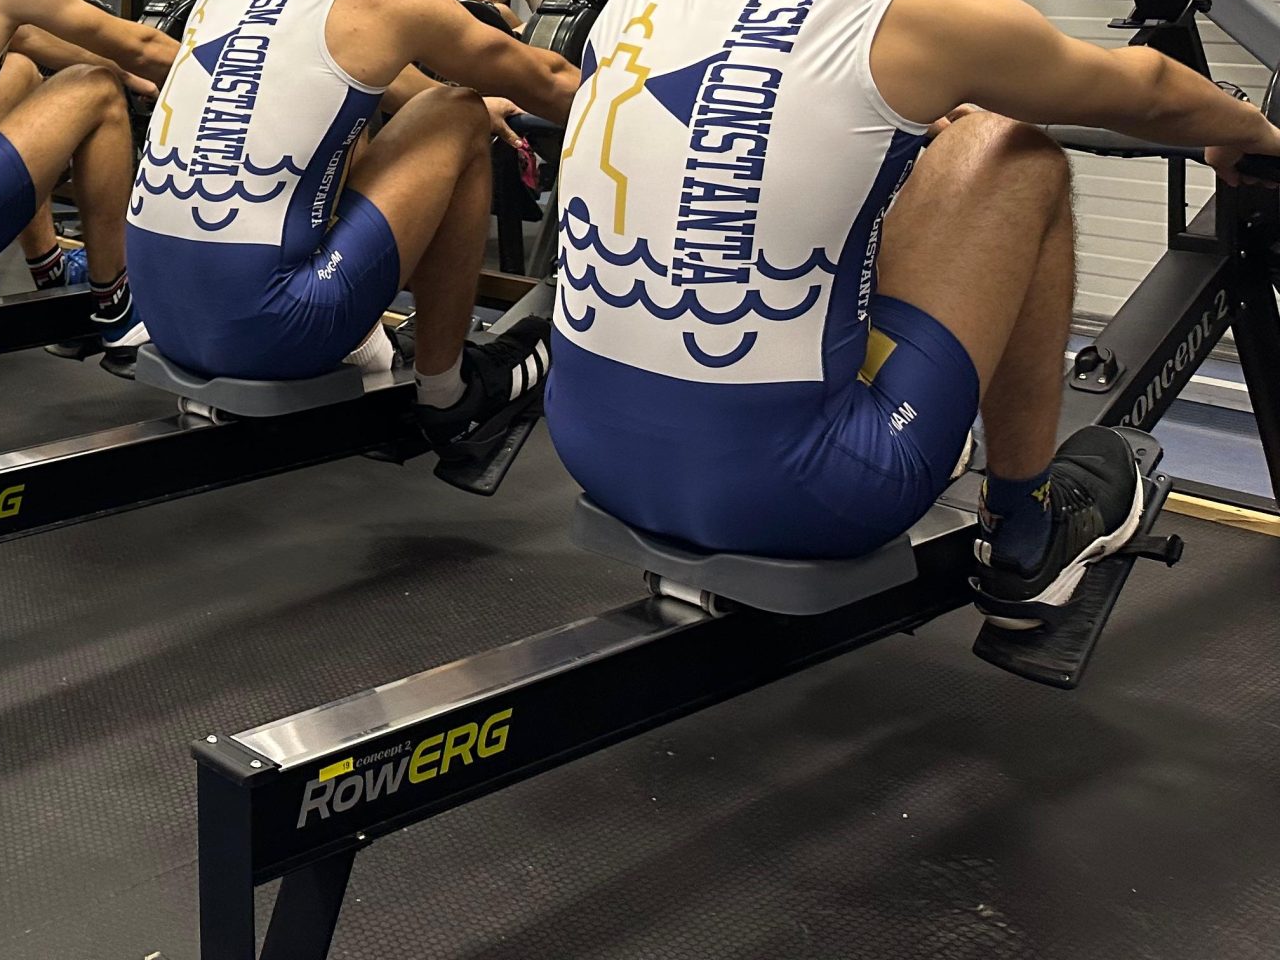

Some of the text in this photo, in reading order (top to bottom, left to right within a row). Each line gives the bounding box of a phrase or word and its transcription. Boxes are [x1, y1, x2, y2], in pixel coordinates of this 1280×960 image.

[1214, 289, 1230, 321] 2
[356, 740, 412, 768] concept 2
